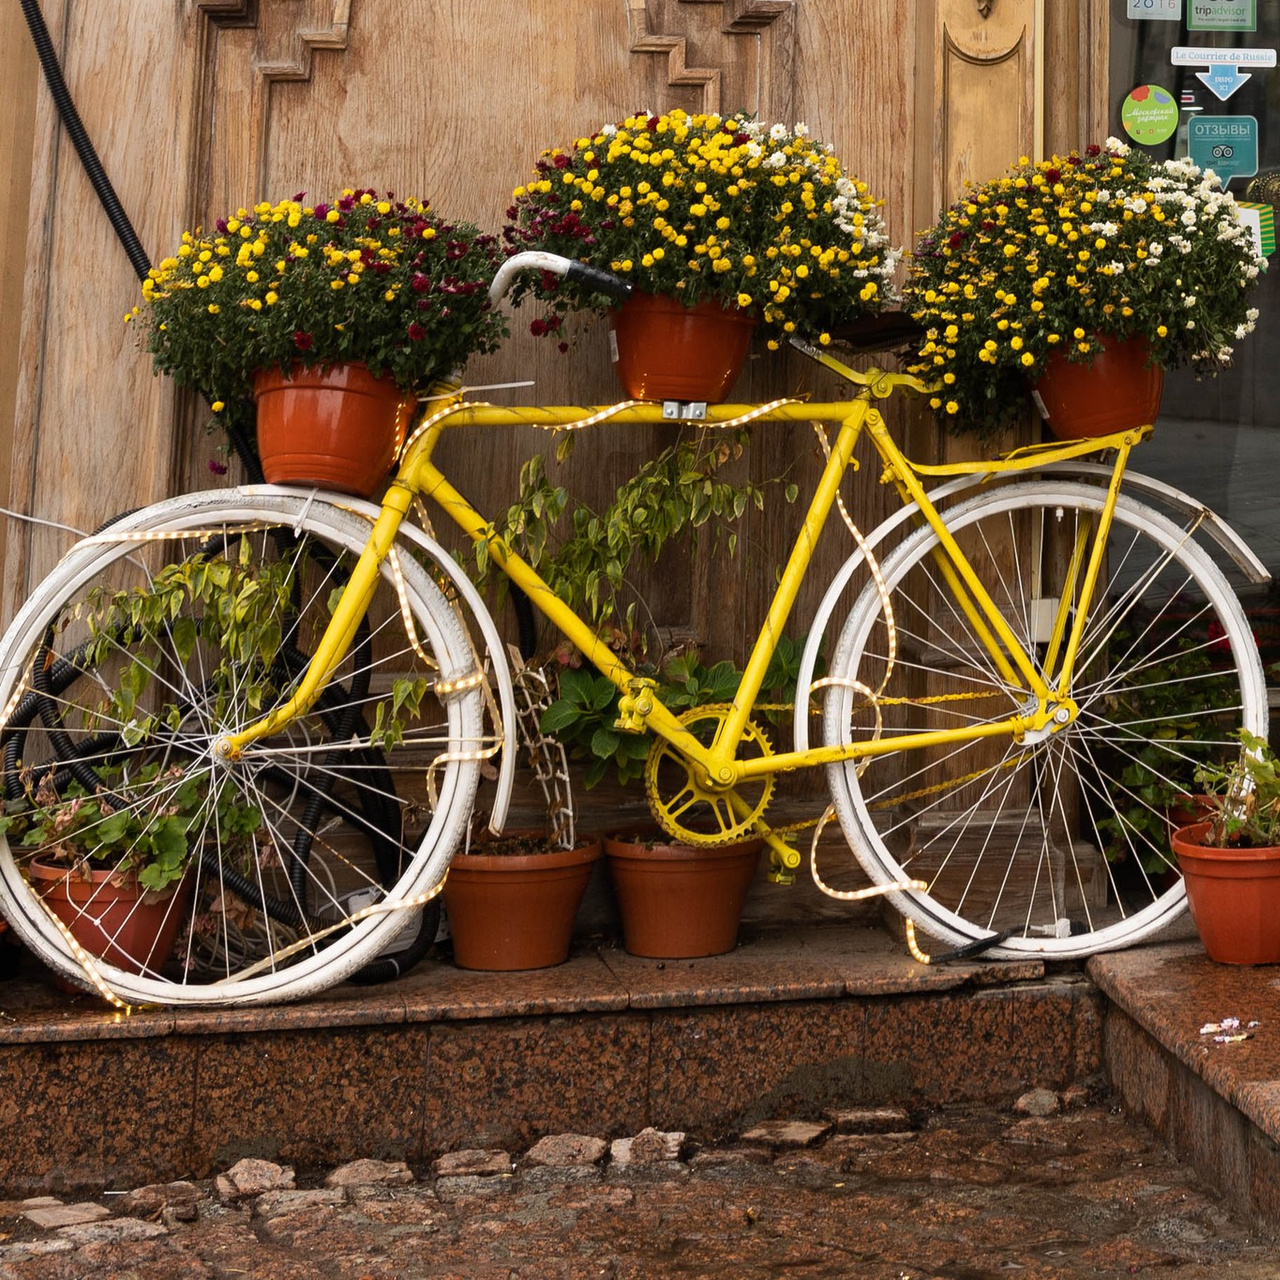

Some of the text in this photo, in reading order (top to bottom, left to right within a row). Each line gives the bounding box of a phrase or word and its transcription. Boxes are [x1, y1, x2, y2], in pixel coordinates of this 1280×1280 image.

[1195, 4, 1246, 17] tripadvisor
[1176, 51, 1273, 61] Le Courrier de Russie
[1195, 125, 1250, 135] ОТЗЫВЫ
